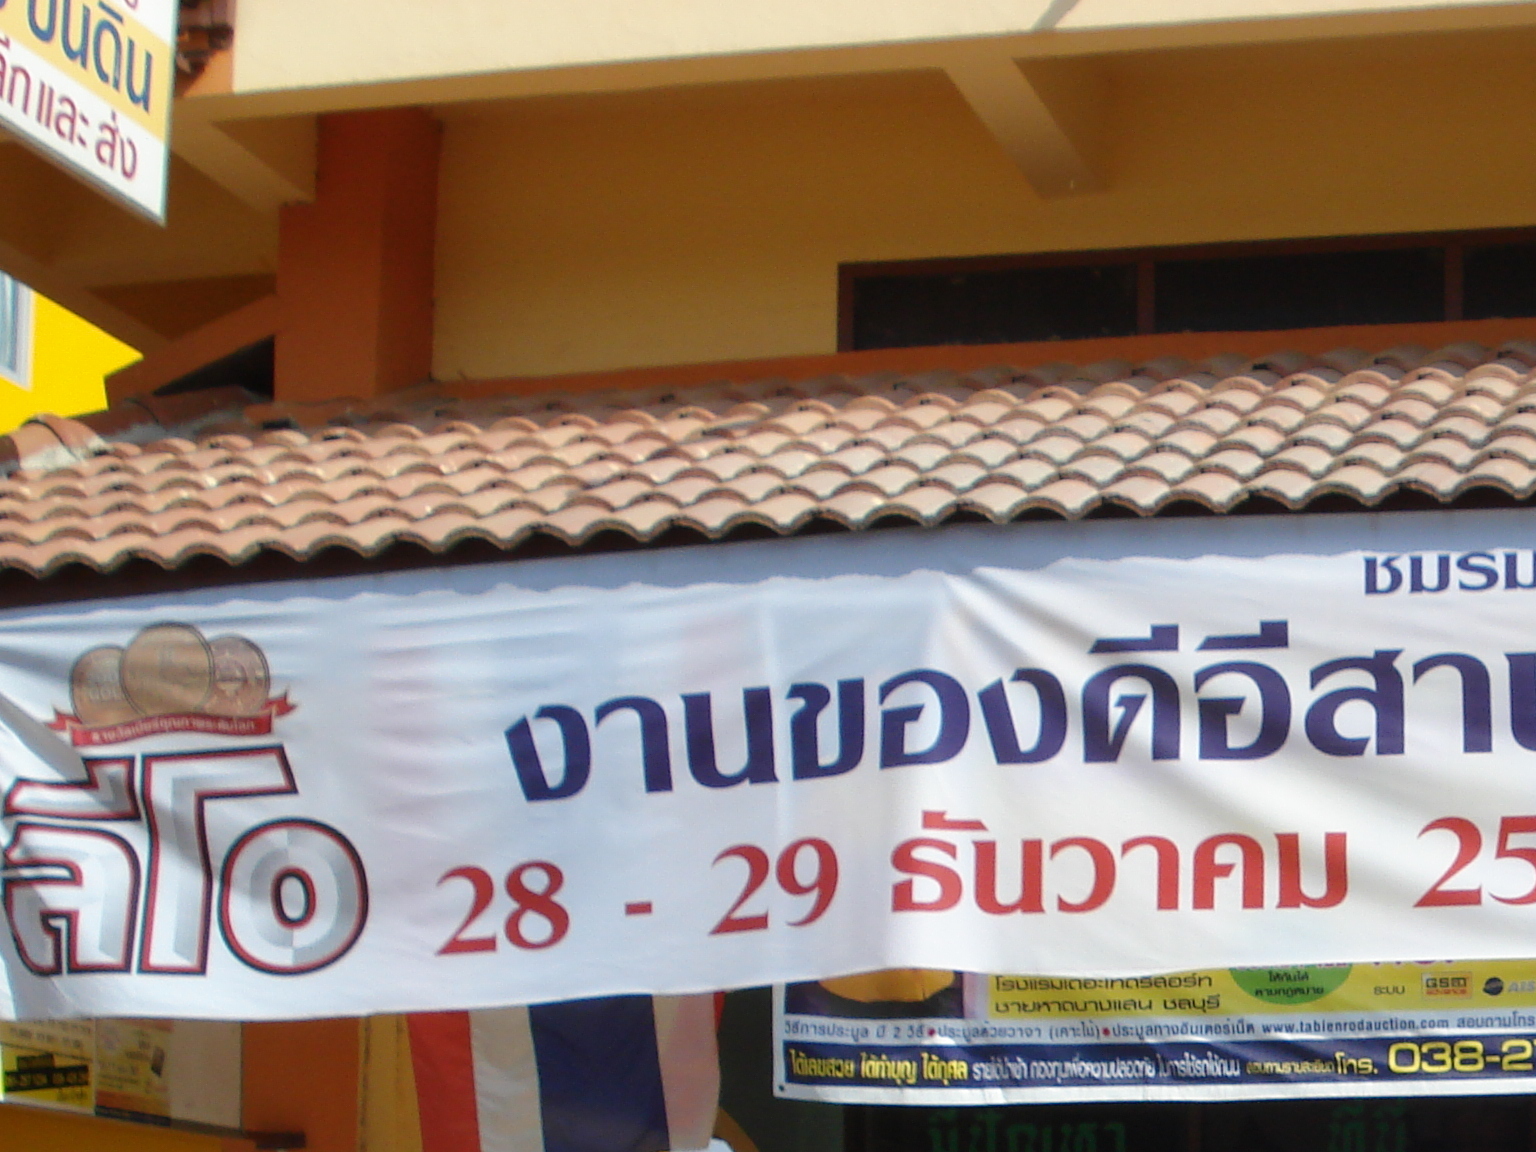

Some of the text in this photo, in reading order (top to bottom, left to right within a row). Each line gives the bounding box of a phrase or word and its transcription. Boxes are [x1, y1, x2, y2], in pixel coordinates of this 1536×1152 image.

[436, 860, 570, 956] 28
[709, 837, 839, 936] 29
[890, 810, 1347, 916] ธันวาคม
